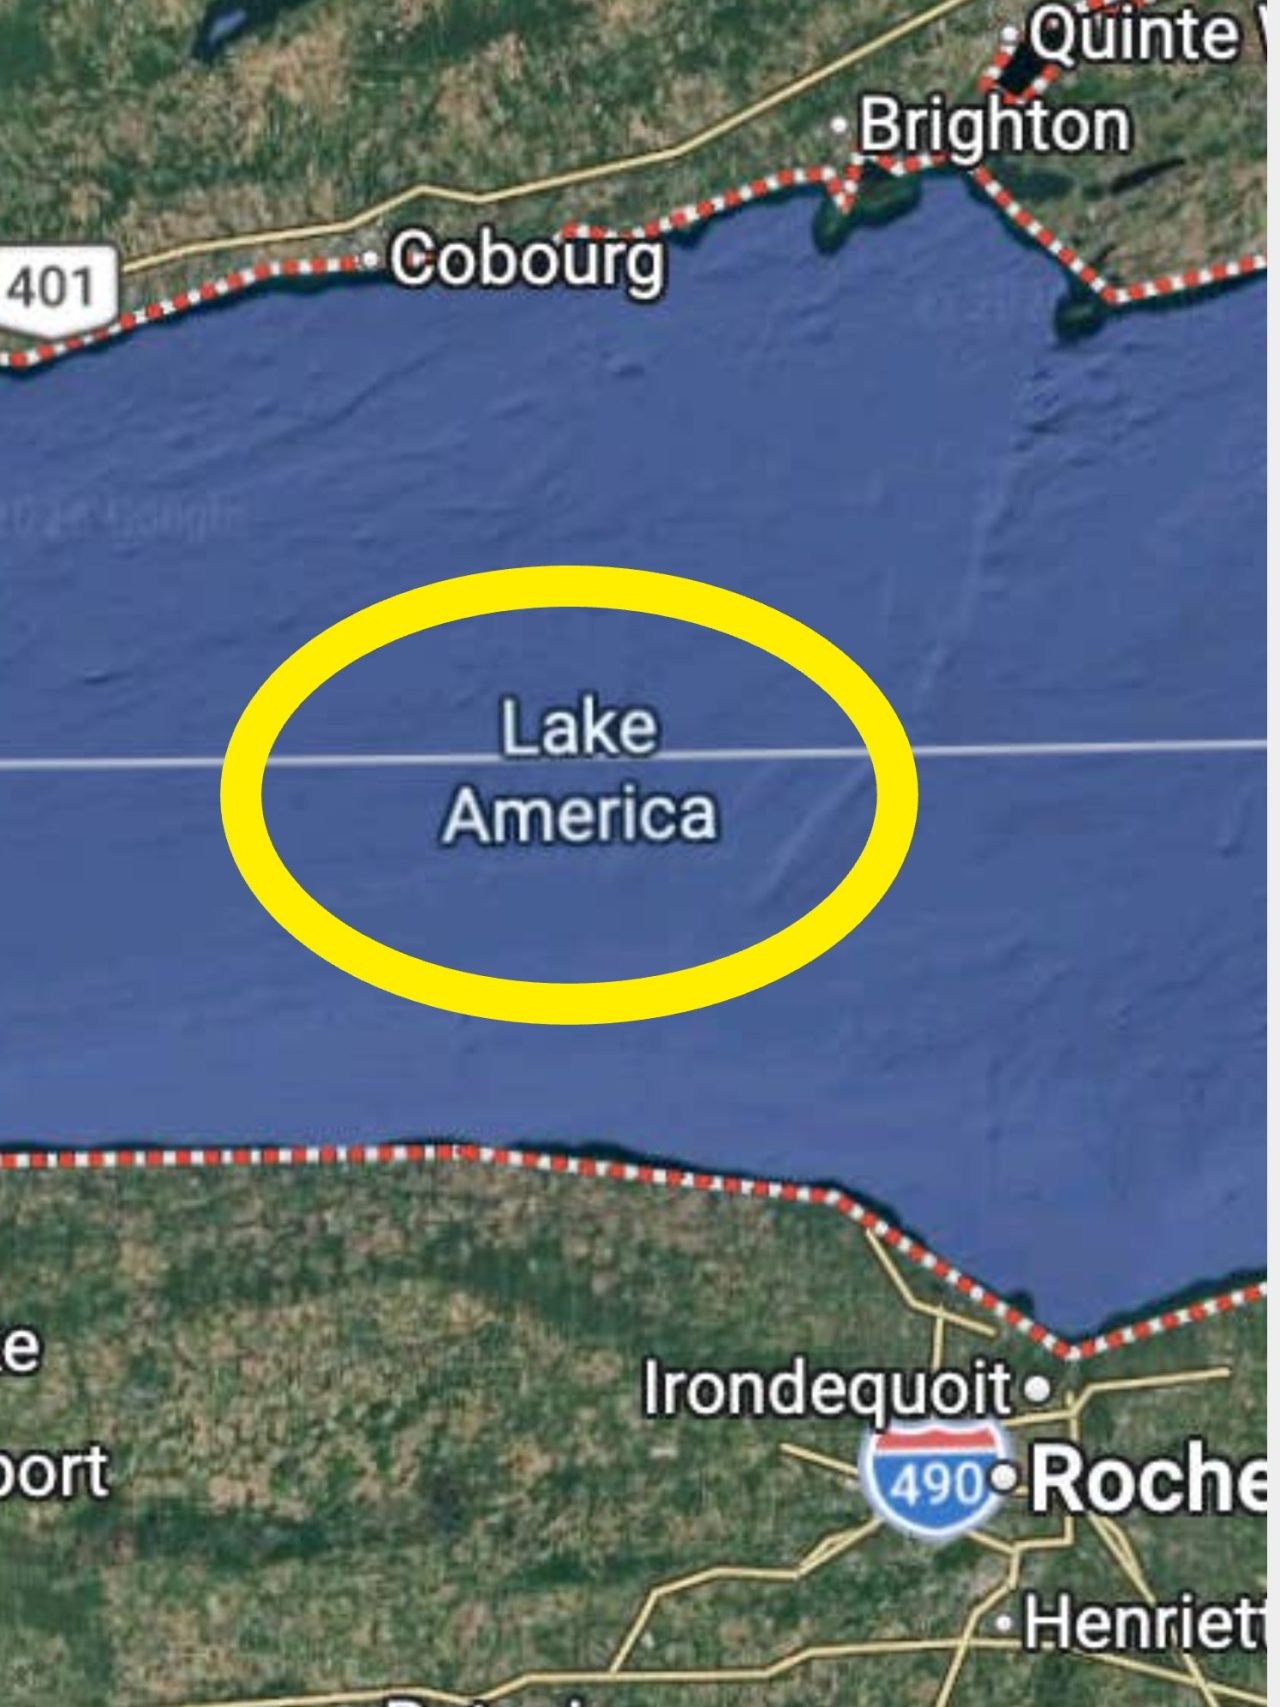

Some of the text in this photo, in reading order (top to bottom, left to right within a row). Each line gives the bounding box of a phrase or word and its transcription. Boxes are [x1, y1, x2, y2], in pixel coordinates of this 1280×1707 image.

[1031, 4, 1238, 66] Quinte
[861, 97, 1129, 164] Brighton
[6, 265, 91, 307] 401
[392, 229, 665, 298] Cobourg
[503, 695, 658, 757] Lake
[440, 784, 717, 844] America
[644, 1358, 1012, 1426] Irondequoit
[890, 1462, 985, 1507] 490
